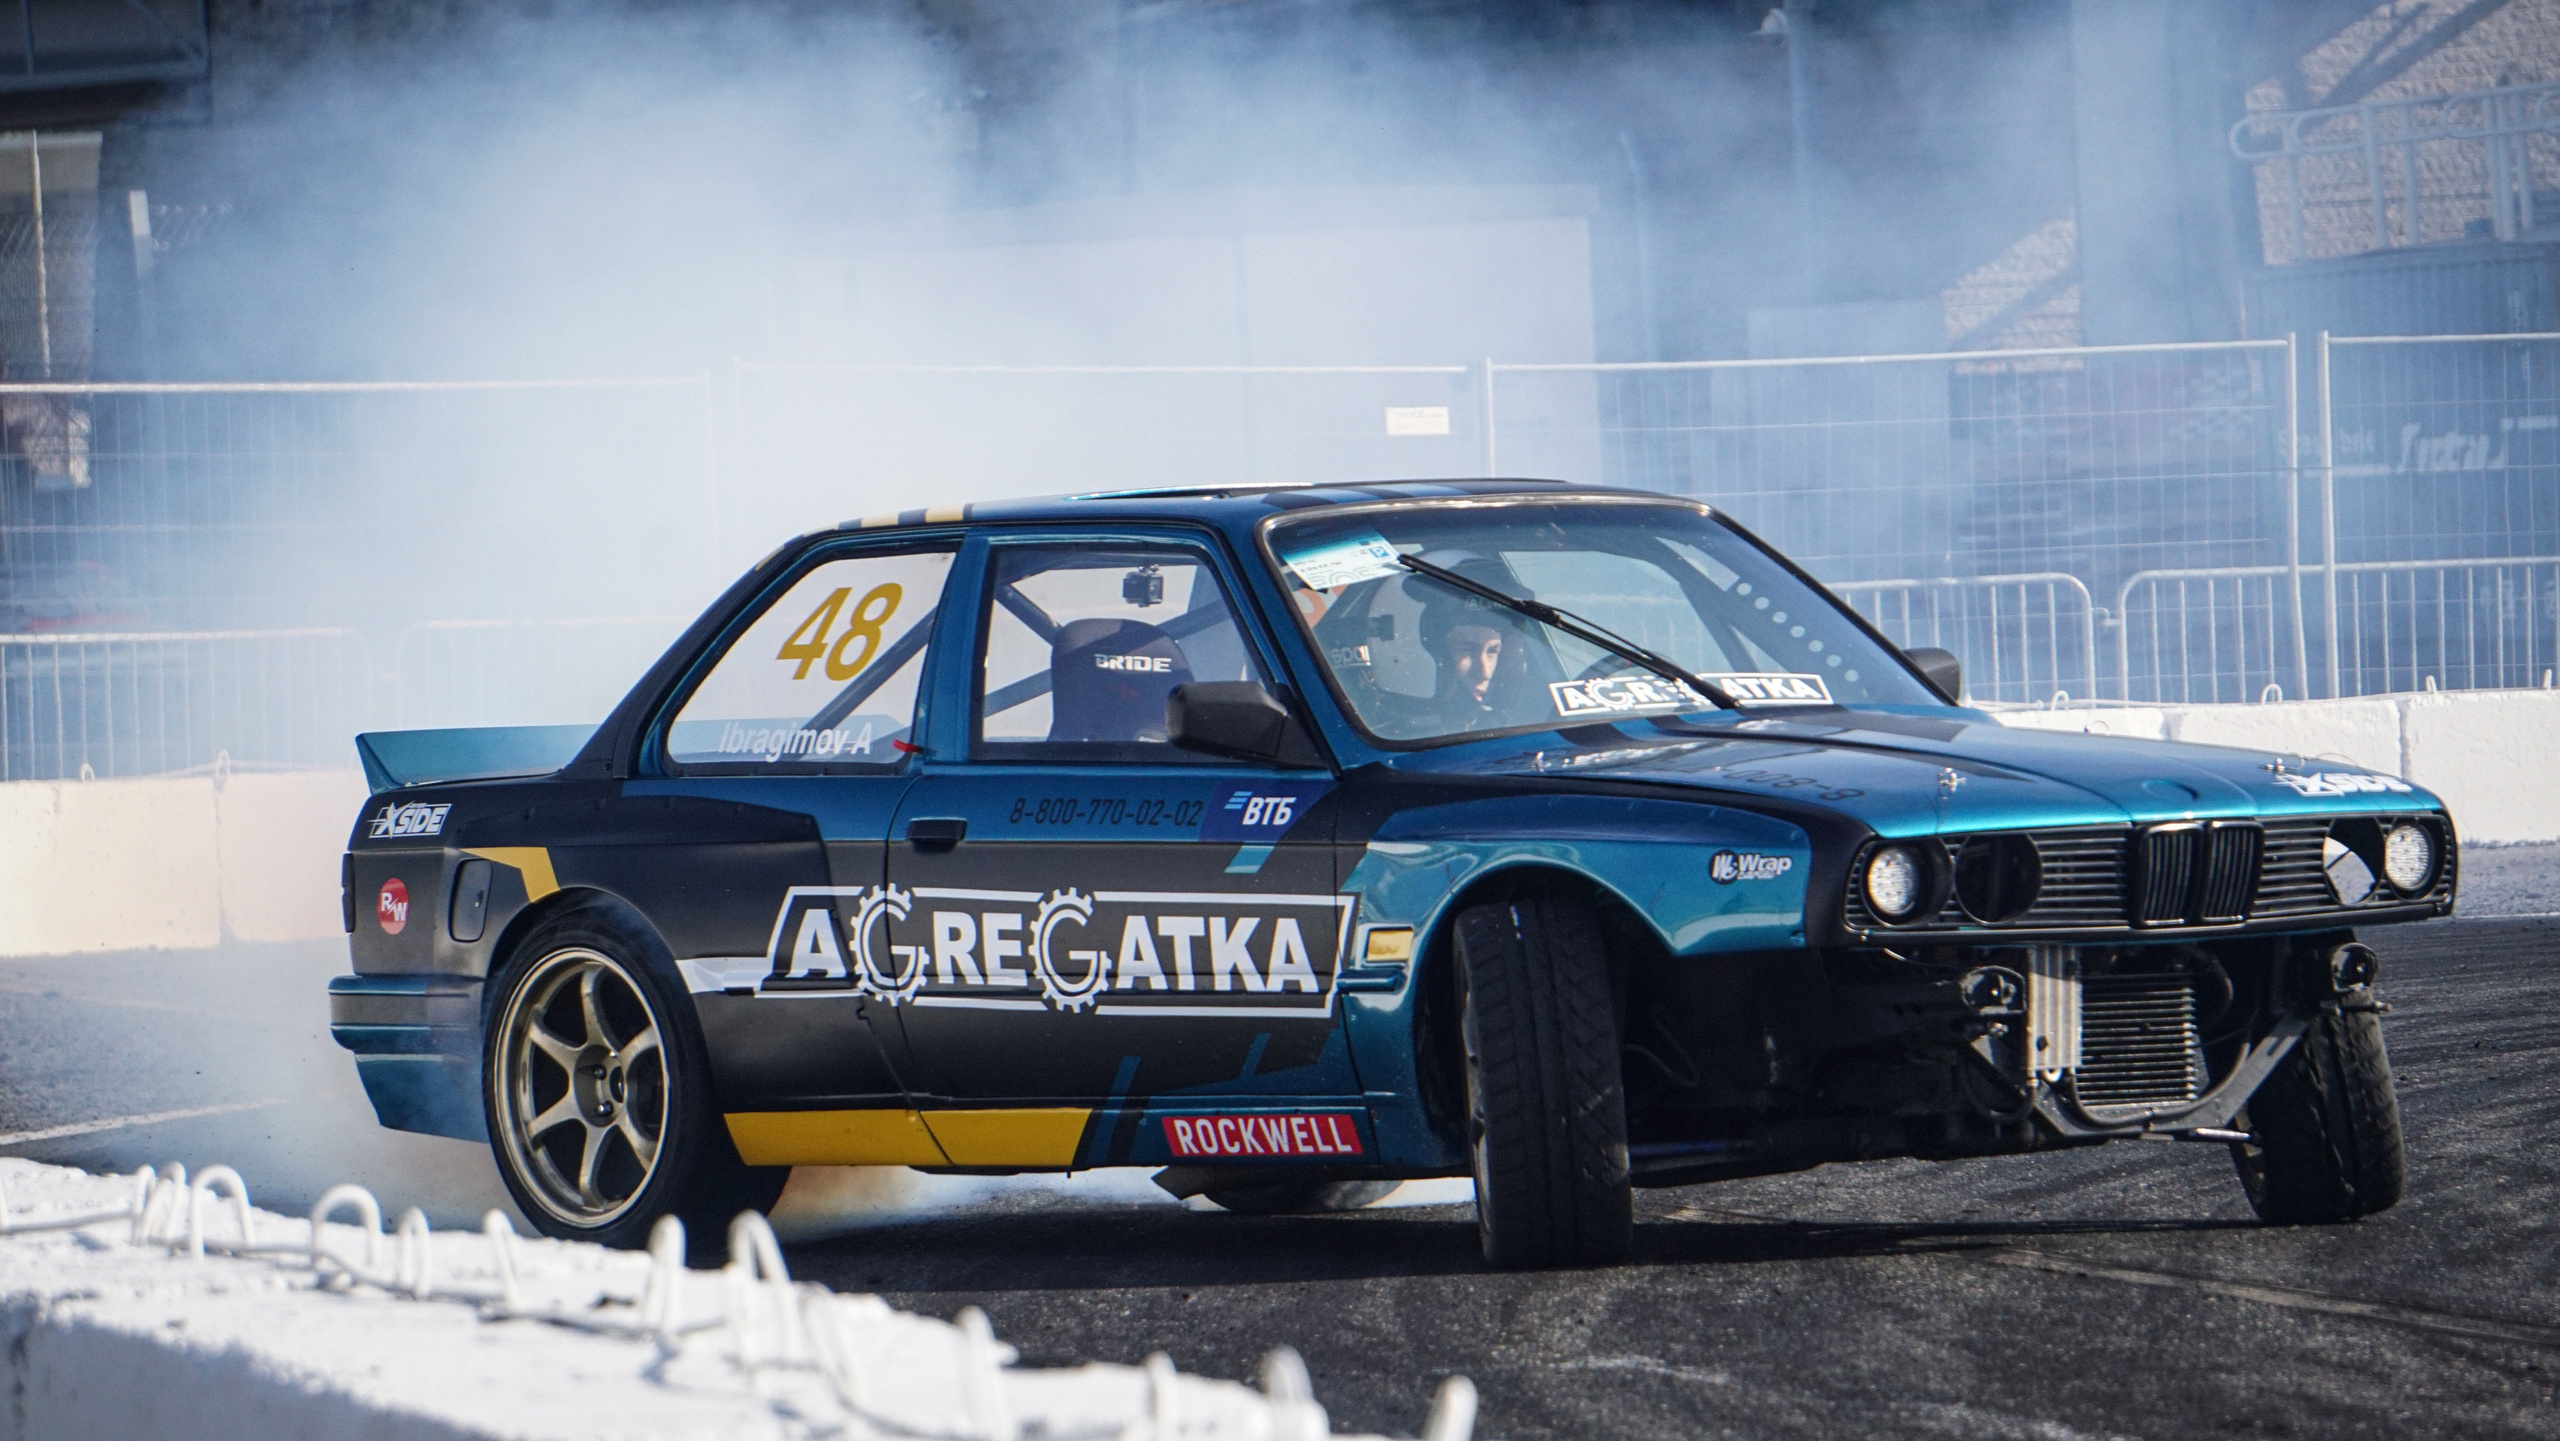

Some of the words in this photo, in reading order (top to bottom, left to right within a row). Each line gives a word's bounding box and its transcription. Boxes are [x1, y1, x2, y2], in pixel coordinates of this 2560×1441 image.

[776, 582, 903, 681] 48
[1094, 653, 1172, 672] BRIDE
[718, 721, 850, 763] Ibragimov
[851, 722, 872, 755] A
[374, 802, 448, 838] XSIDE
[1010, 798, 1204, 826] 8-800-770-02-02
[1242, 797, 1297, 826] ВТБ
[1738, 854, 1793, 875] Wrap
[789, 883, 1320, 1013] AGREGATKA
[1174, 1117, 1353, 1154] ROCKWELL
